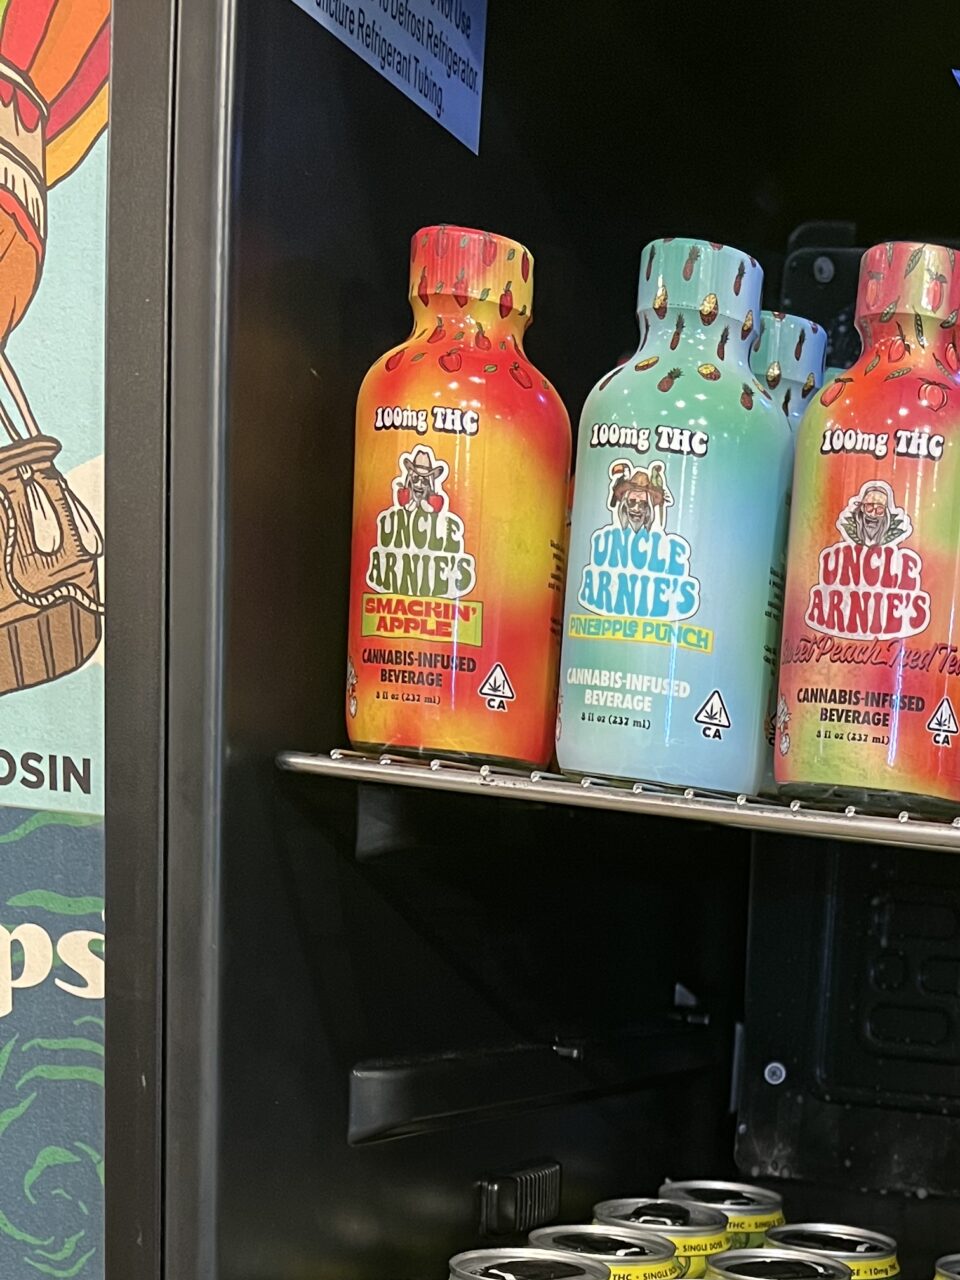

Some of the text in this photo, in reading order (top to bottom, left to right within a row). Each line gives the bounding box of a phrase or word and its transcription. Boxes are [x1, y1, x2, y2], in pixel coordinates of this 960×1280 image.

[455, 1, 472, 40] Use
[356, 8, 445, 119] Refrigerant Tubing.
[426, 20, 479, 95] Refrigerator.
[375, 406, 480, 435] 100mg THC
[590, 423, 709, 458] 100mg THC
[820, 428, 945, 461] 100mg THC
[379, 507, 461, 553] UNCLE
[594, 528, 685, 576] UNCLE
[822, 546, 918, 590] UNCLE
[369, 551, 472, 596] ARNIE'S
[365, 597, 477, 622] SMACKIN'
[580, 570, 696, 617] ARNIE'S
[376, 616, 453, 638] APPLE
[808, 589, 927, 634] ARNIE'S
[642, 623, 709, 649] PUNCH
[814, 636, 887, 665] Peach
[380, 669, 442, 687] BEVERAGE
[567, 668, 690, 698] CANNABIS-INFUSED
[584, 689, 652, 711] BEVERAGE
[702, 726, 722, 740] CA
[820, 708, 890, 727] BEVERAGE
